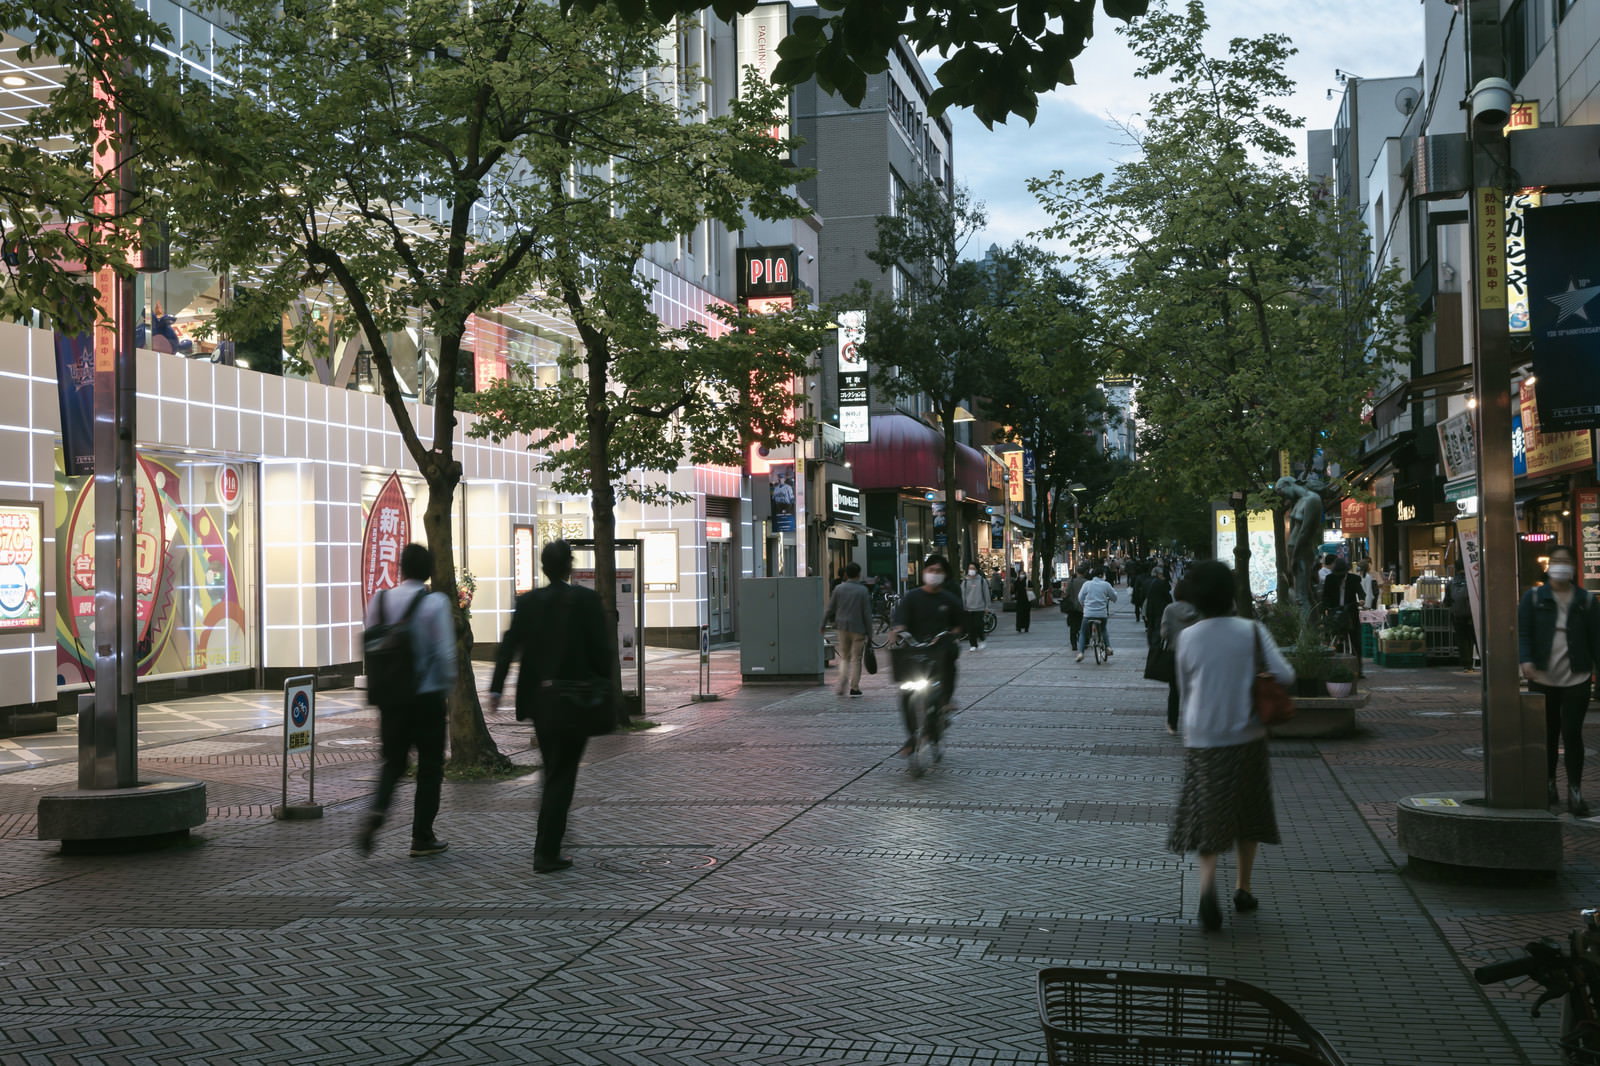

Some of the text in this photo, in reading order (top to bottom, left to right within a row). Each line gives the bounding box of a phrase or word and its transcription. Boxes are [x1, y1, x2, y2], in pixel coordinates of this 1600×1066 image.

[758, 25, 766, 76] PACHINKO
[1484, 193, 1498, 290] 防犯カメラ作動中
[750, 257, 788, 284] PIA
[1009, 453, 1018, 495] ART
[376, 506, 400, 592] 新台入
